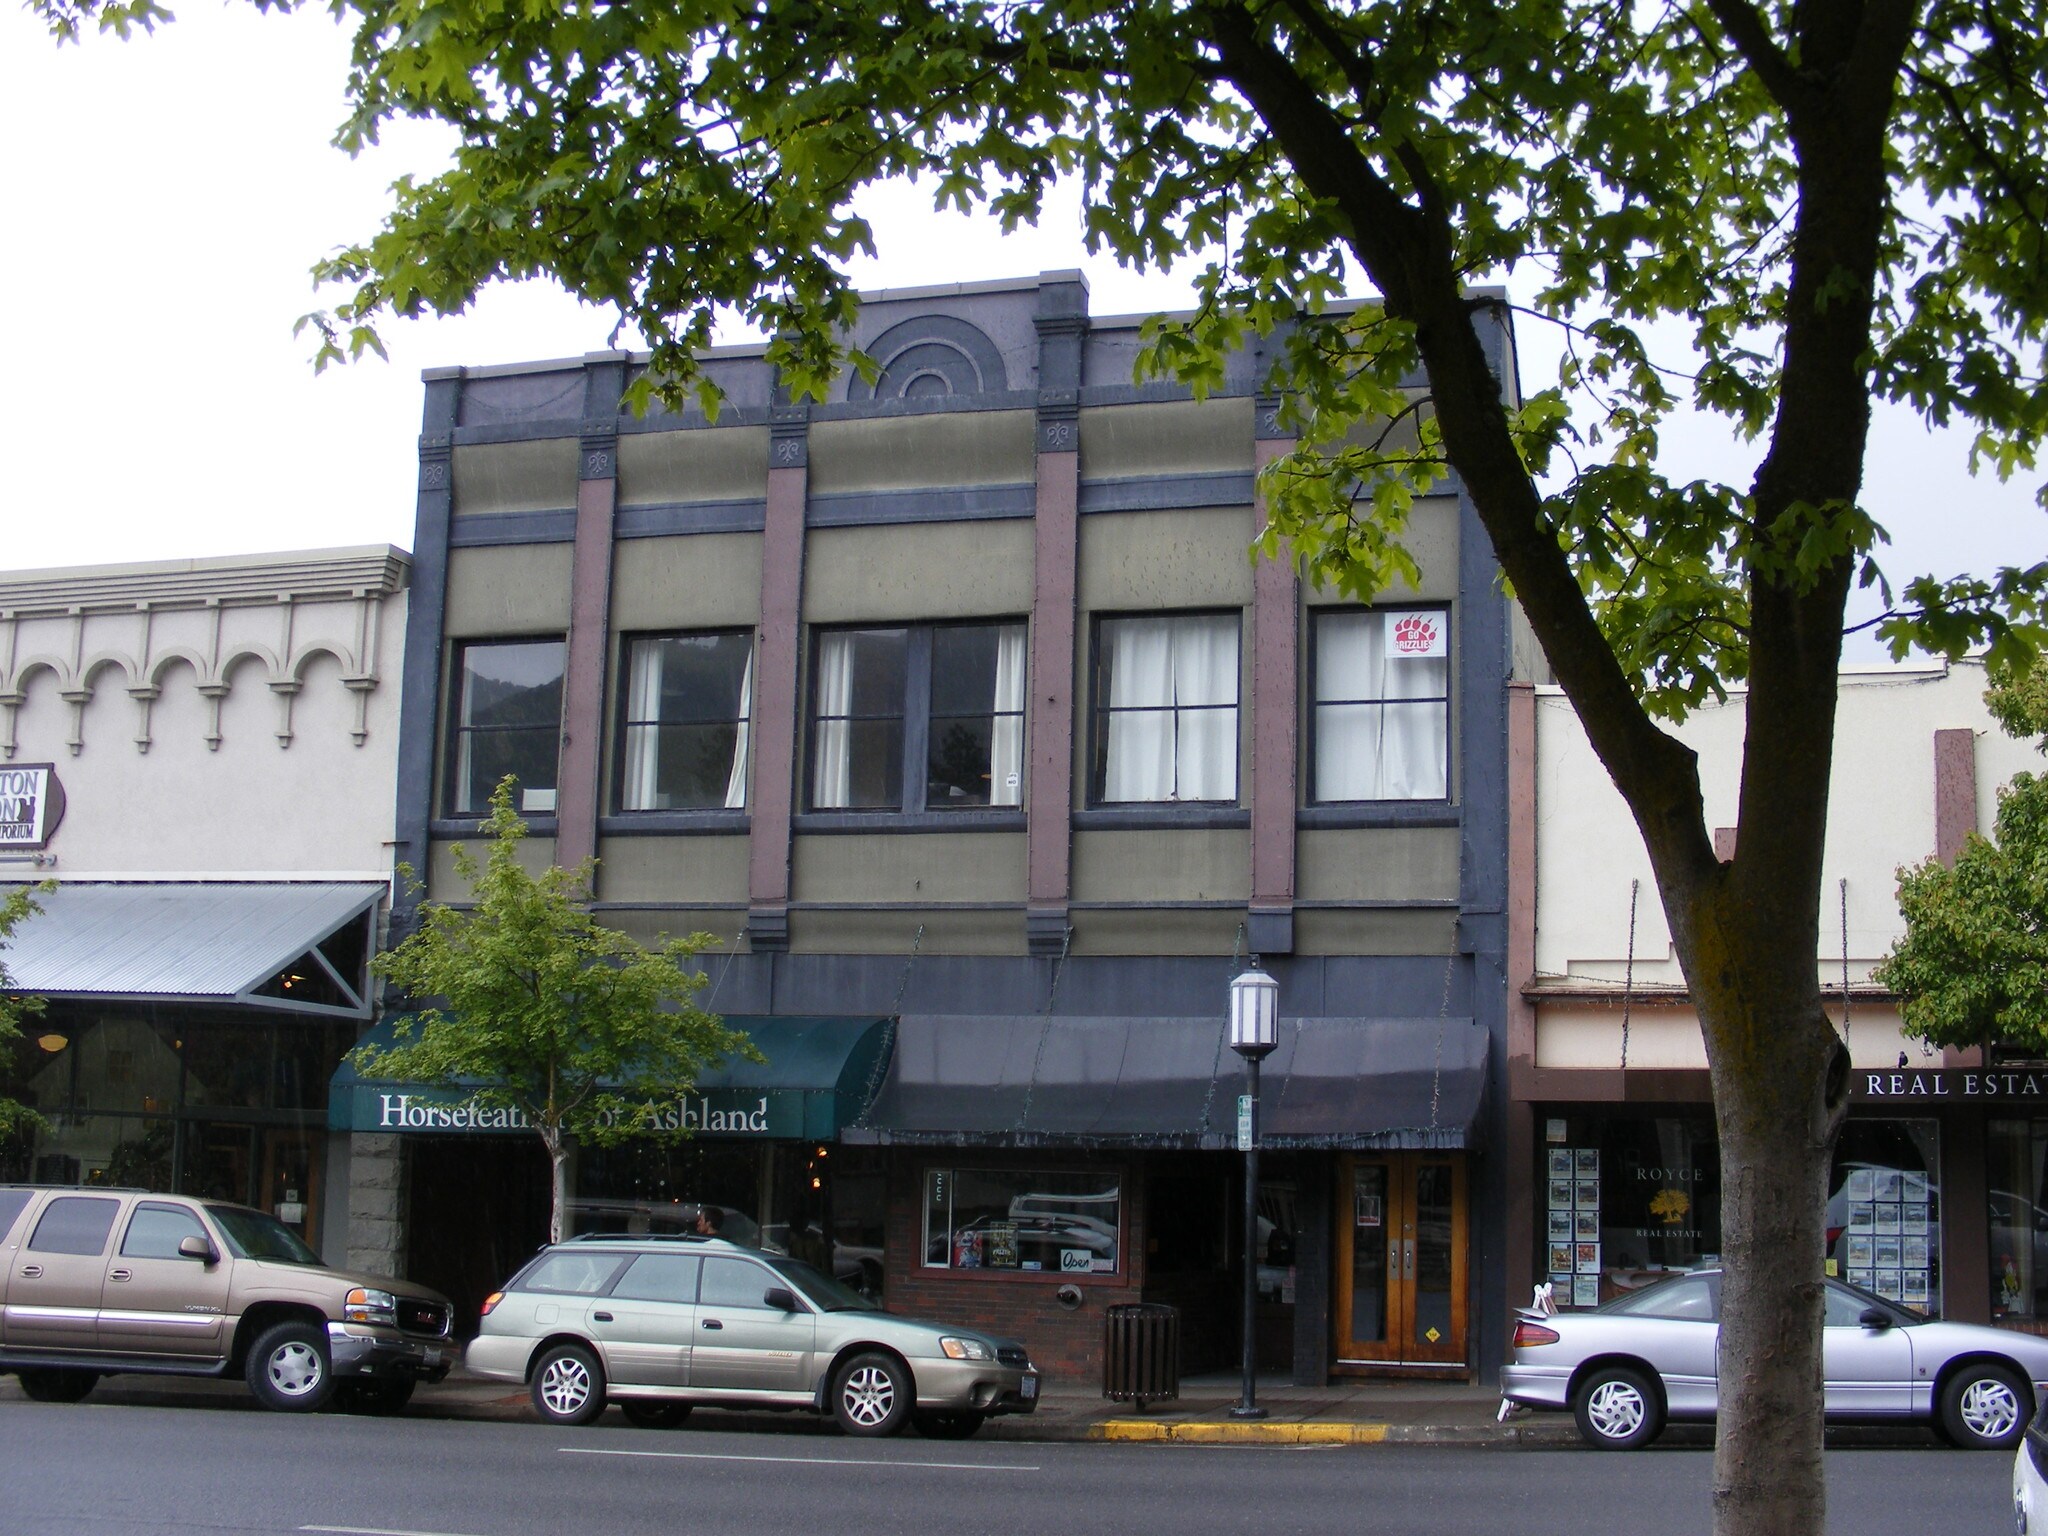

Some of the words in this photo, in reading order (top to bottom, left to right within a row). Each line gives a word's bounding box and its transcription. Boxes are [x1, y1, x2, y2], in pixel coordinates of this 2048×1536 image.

[1407, 630, 1420, 640] GO
[1393, 640, 1435, 650] GRIZZLIES
[0, 797, 18, 822] N
[0, 824, 34, 839] PORIUM
[1866, 1074, 1949, 1095] REAL
[380, 1094, 567, 1129] Horsefeat
[641, 1096, 769, 1132] Ashland
[1636, 1168, 1703, 1181] ROYCE
[1636, 1229, 1662, 1237] REAL
[1666, 1229, 1703, 1238] ESTATE
[1062, 1251, 1090, 1270] Open
